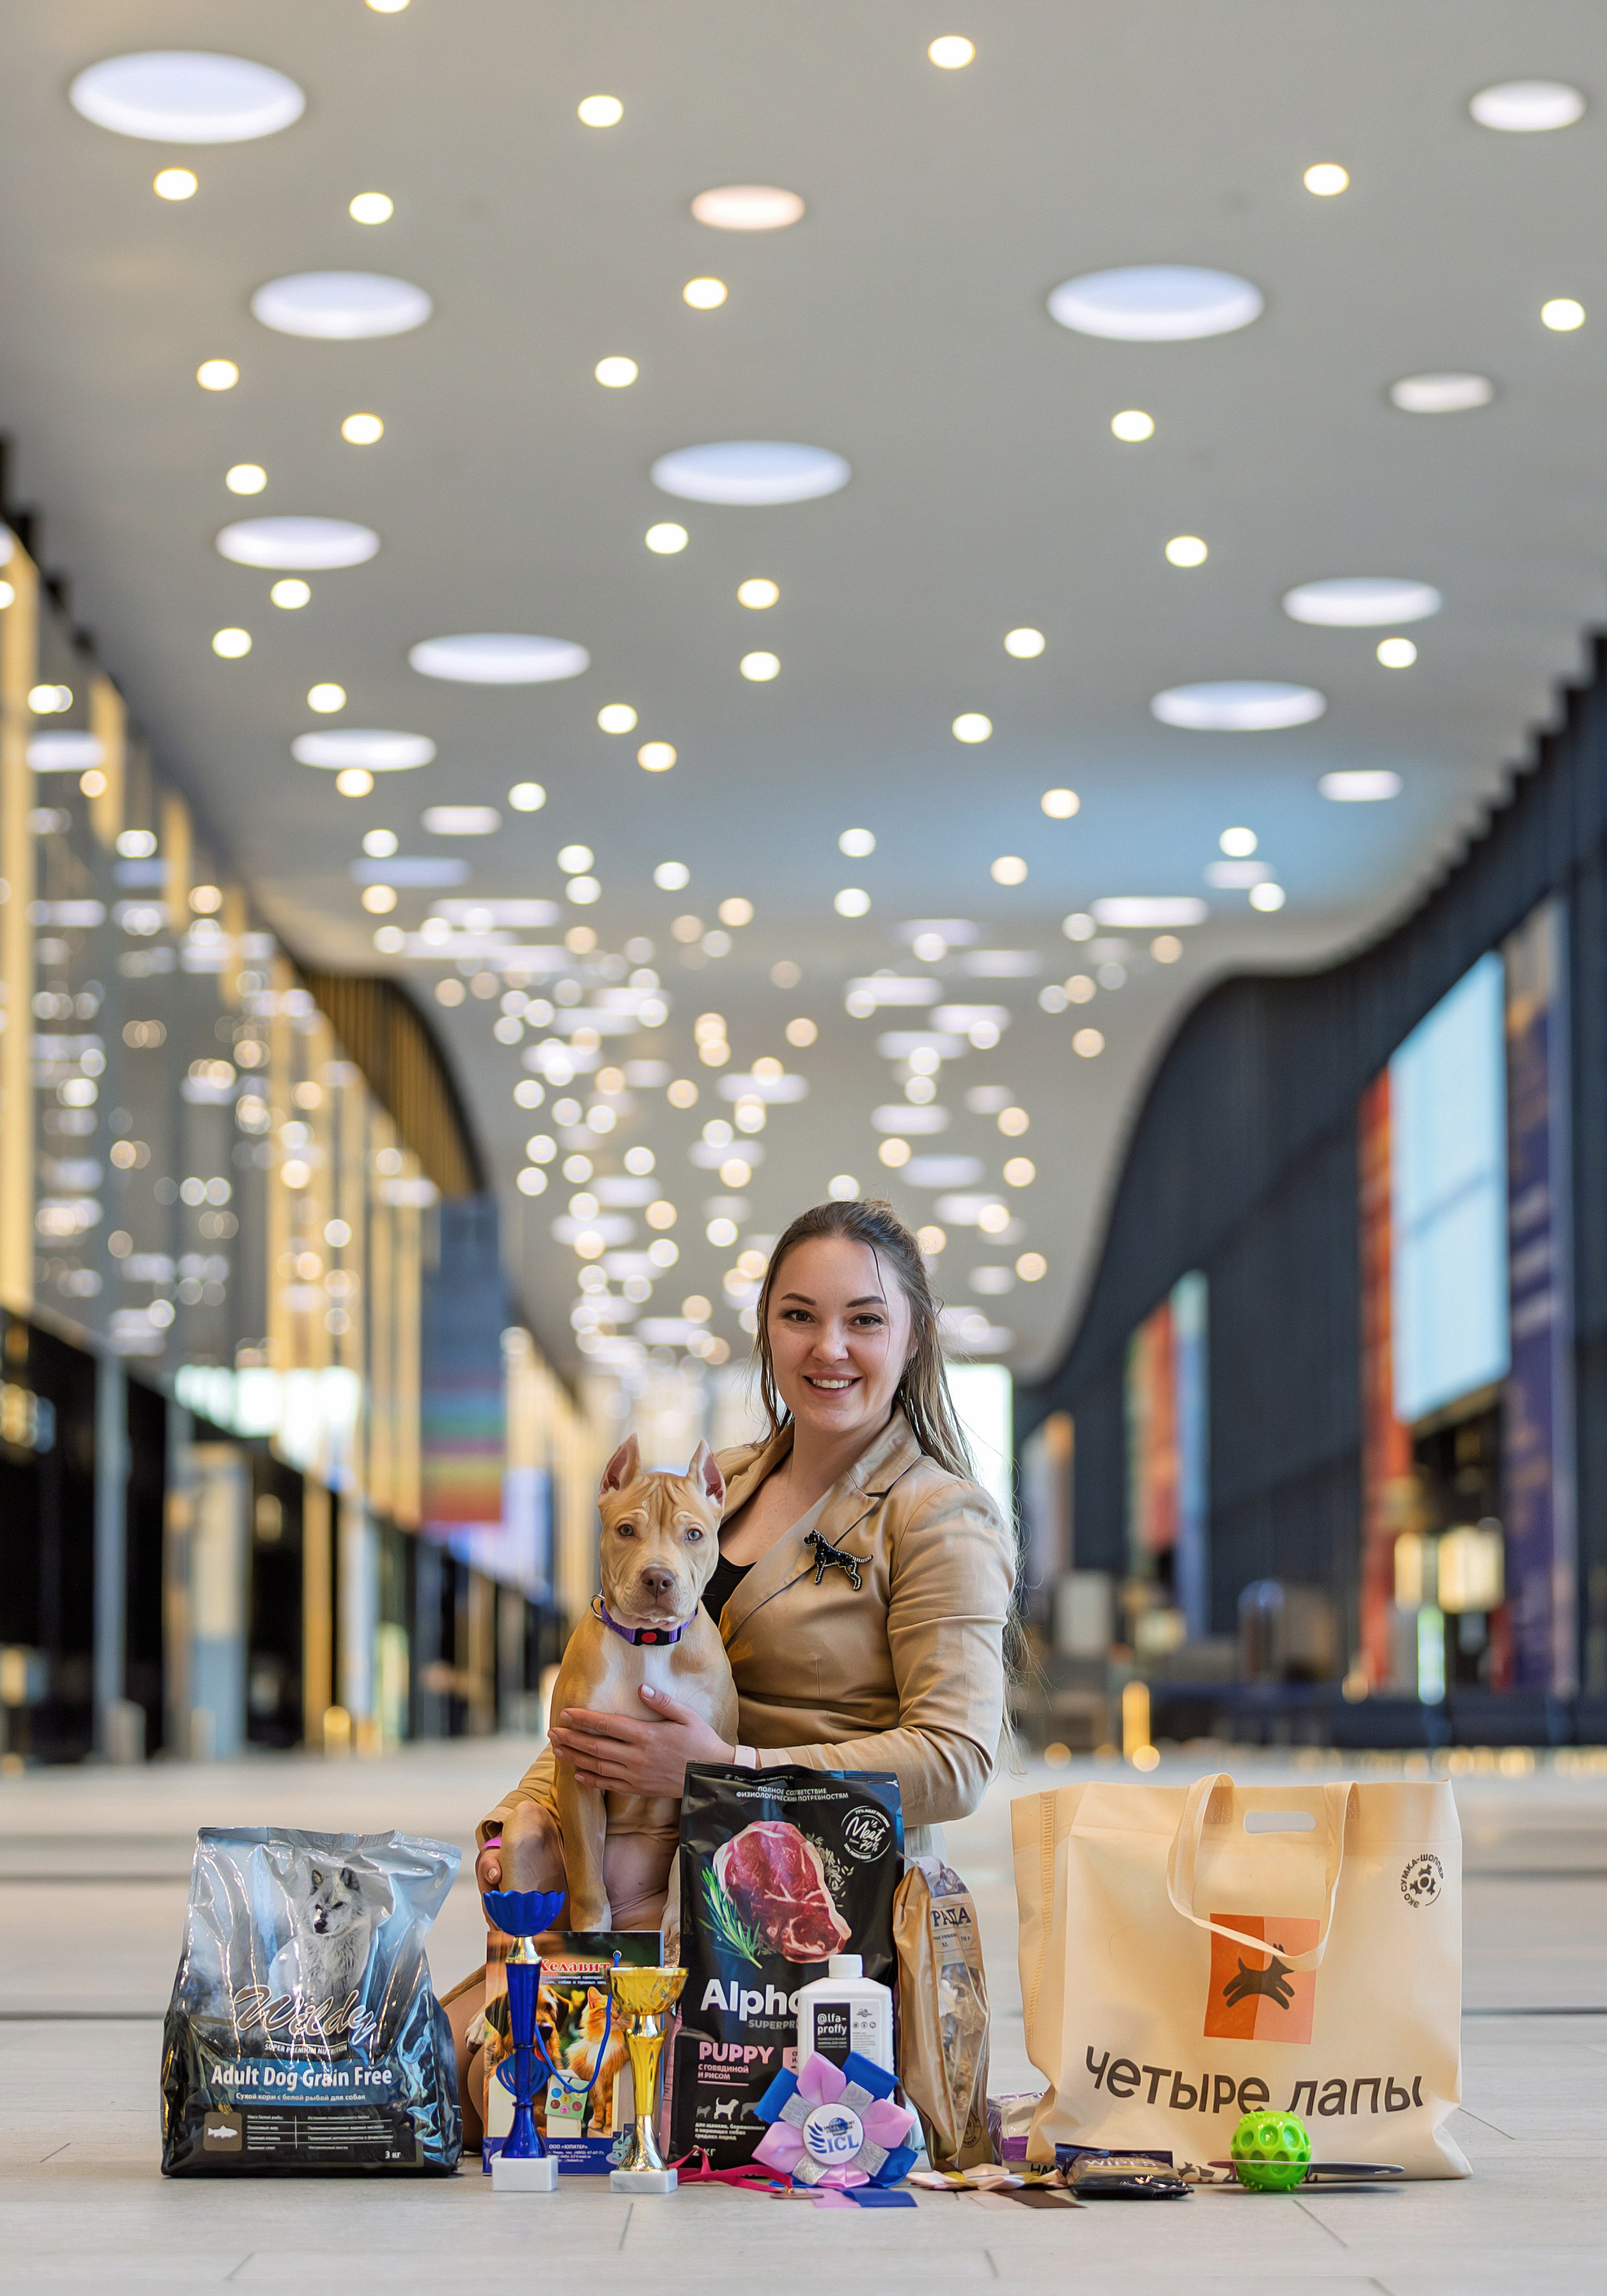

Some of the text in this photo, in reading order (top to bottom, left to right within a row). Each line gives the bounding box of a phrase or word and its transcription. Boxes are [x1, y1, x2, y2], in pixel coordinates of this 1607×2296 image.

[757, 1786, 784, 1795] ПОЛНОЕ
[798, 1792, 849, 1802] ПОТРЕБНОСТЯМ
[845, 1816, 886, 1841] Meat
[931, 1907, 971, 1927] РАДА
[234, 1984, 377, 2046] Wildy
[817, 2013, 847, 2025] @lfa-
[748, 2019, 796, 2030] SUPERPR
[817, 2024, 847, 2036] proffy
[264, 2043, 285, 2052] SUPER
[699, 2041, 775, 2064] PUPPY
[704, 2064, 749, 2073] ГОВЯДИНОЙ
[211, 2065, 392, 2091] Adult Dog Grain Free
[1086, 2045, 1424, 2116] четыре лапы
[235, 2092, 257, 2100] Сухой
[827, 2135, 859, 2153] ICL
